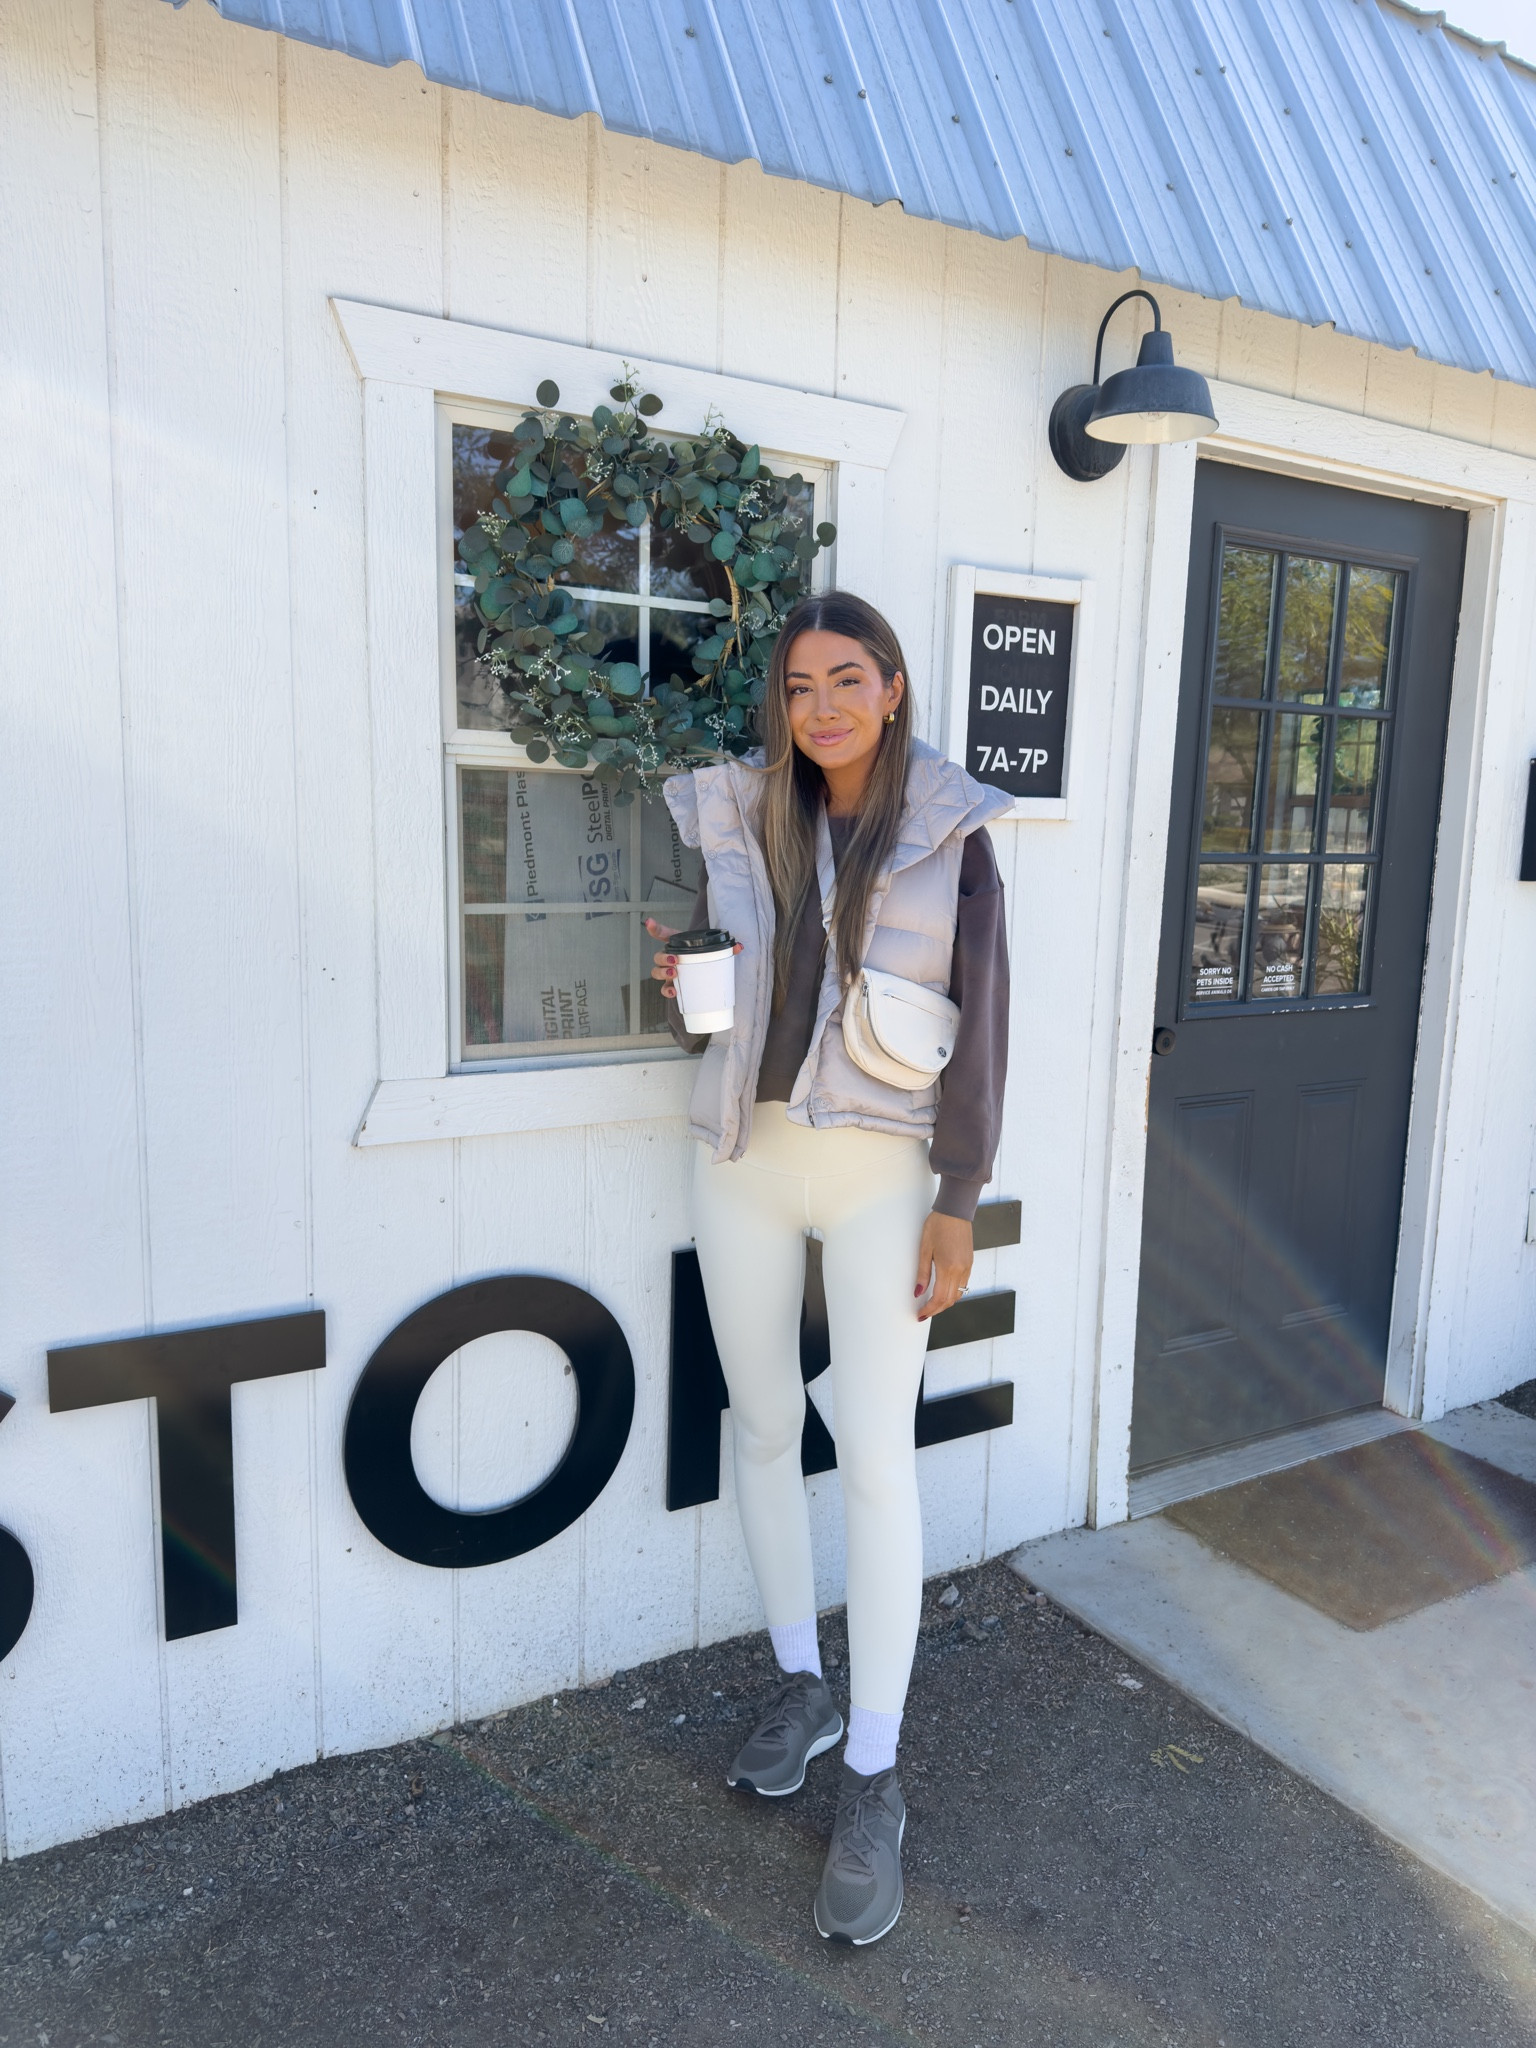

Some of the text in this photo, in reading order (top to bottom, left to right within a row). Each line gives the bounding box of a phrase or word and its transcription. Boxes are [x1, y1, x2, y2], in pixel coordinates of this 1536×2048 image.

[982, 623, 1057, 656] OPEN
[980, 685, 1054, 715] DAILY
[976, 745, 1049, 774] 7A-7P
[603, 809, 613, 841] DIGITAL
[520, 810, 539, 898] Piedmont
[668, 814, 682, 883] iedmont
[1196, 976, 1234, 986] PETS INSIDE
[1199, 966, 1232, 976] SORRY NO
[1263, 974, 1295, 983] ACCEPTED
[1266, 964, 1294, 973] NO CASH
